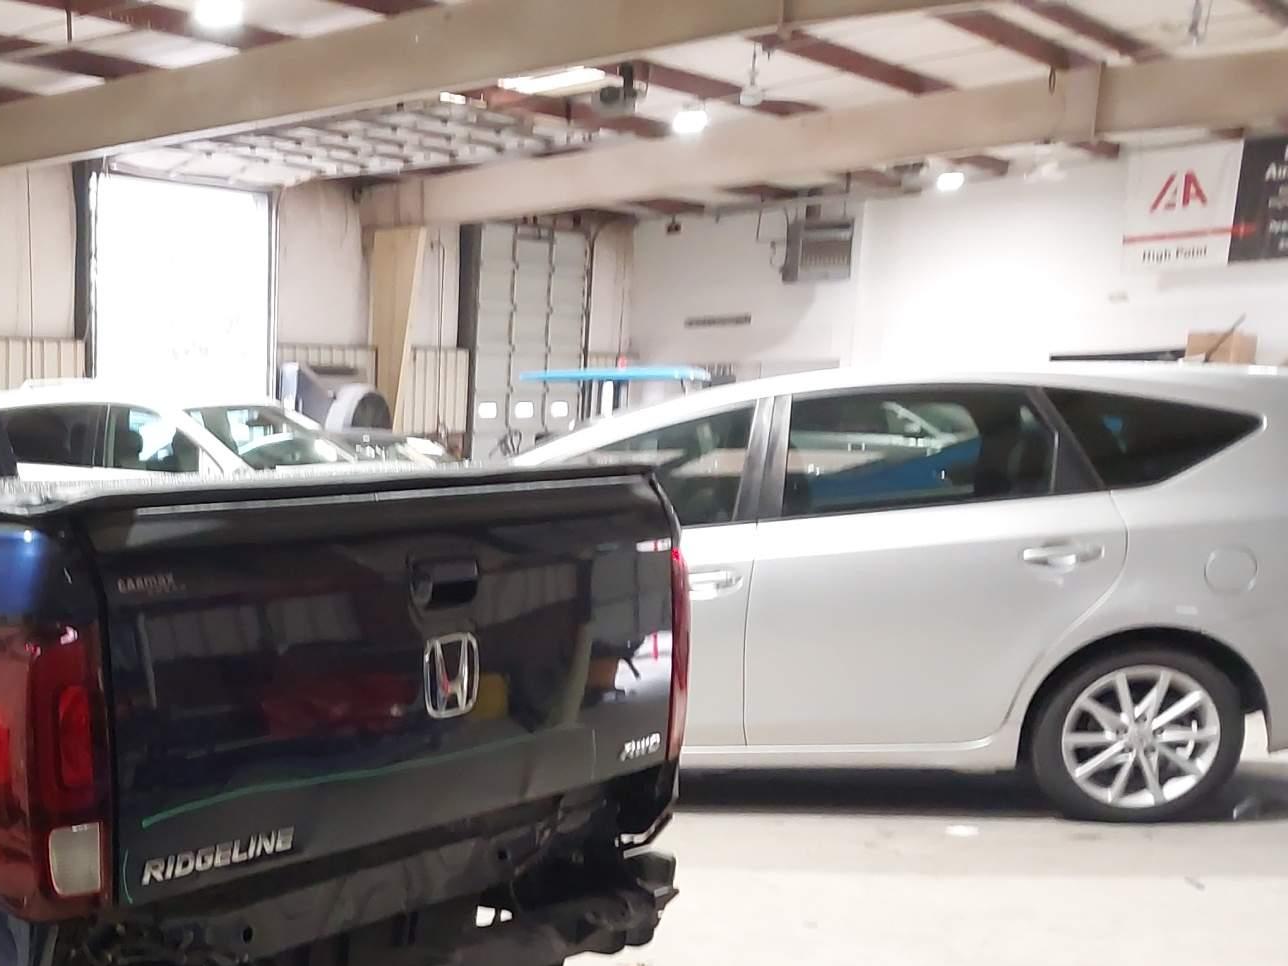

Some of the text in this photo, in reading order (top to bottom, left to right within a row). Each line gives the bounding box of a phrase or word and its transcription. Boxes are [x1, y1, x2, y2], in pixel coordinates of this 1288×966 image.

[1142, 245, 1208, 265] High Point
[619, 732, 661, 762] AWD
[141, 826, 295, 886] RIDGELINE
